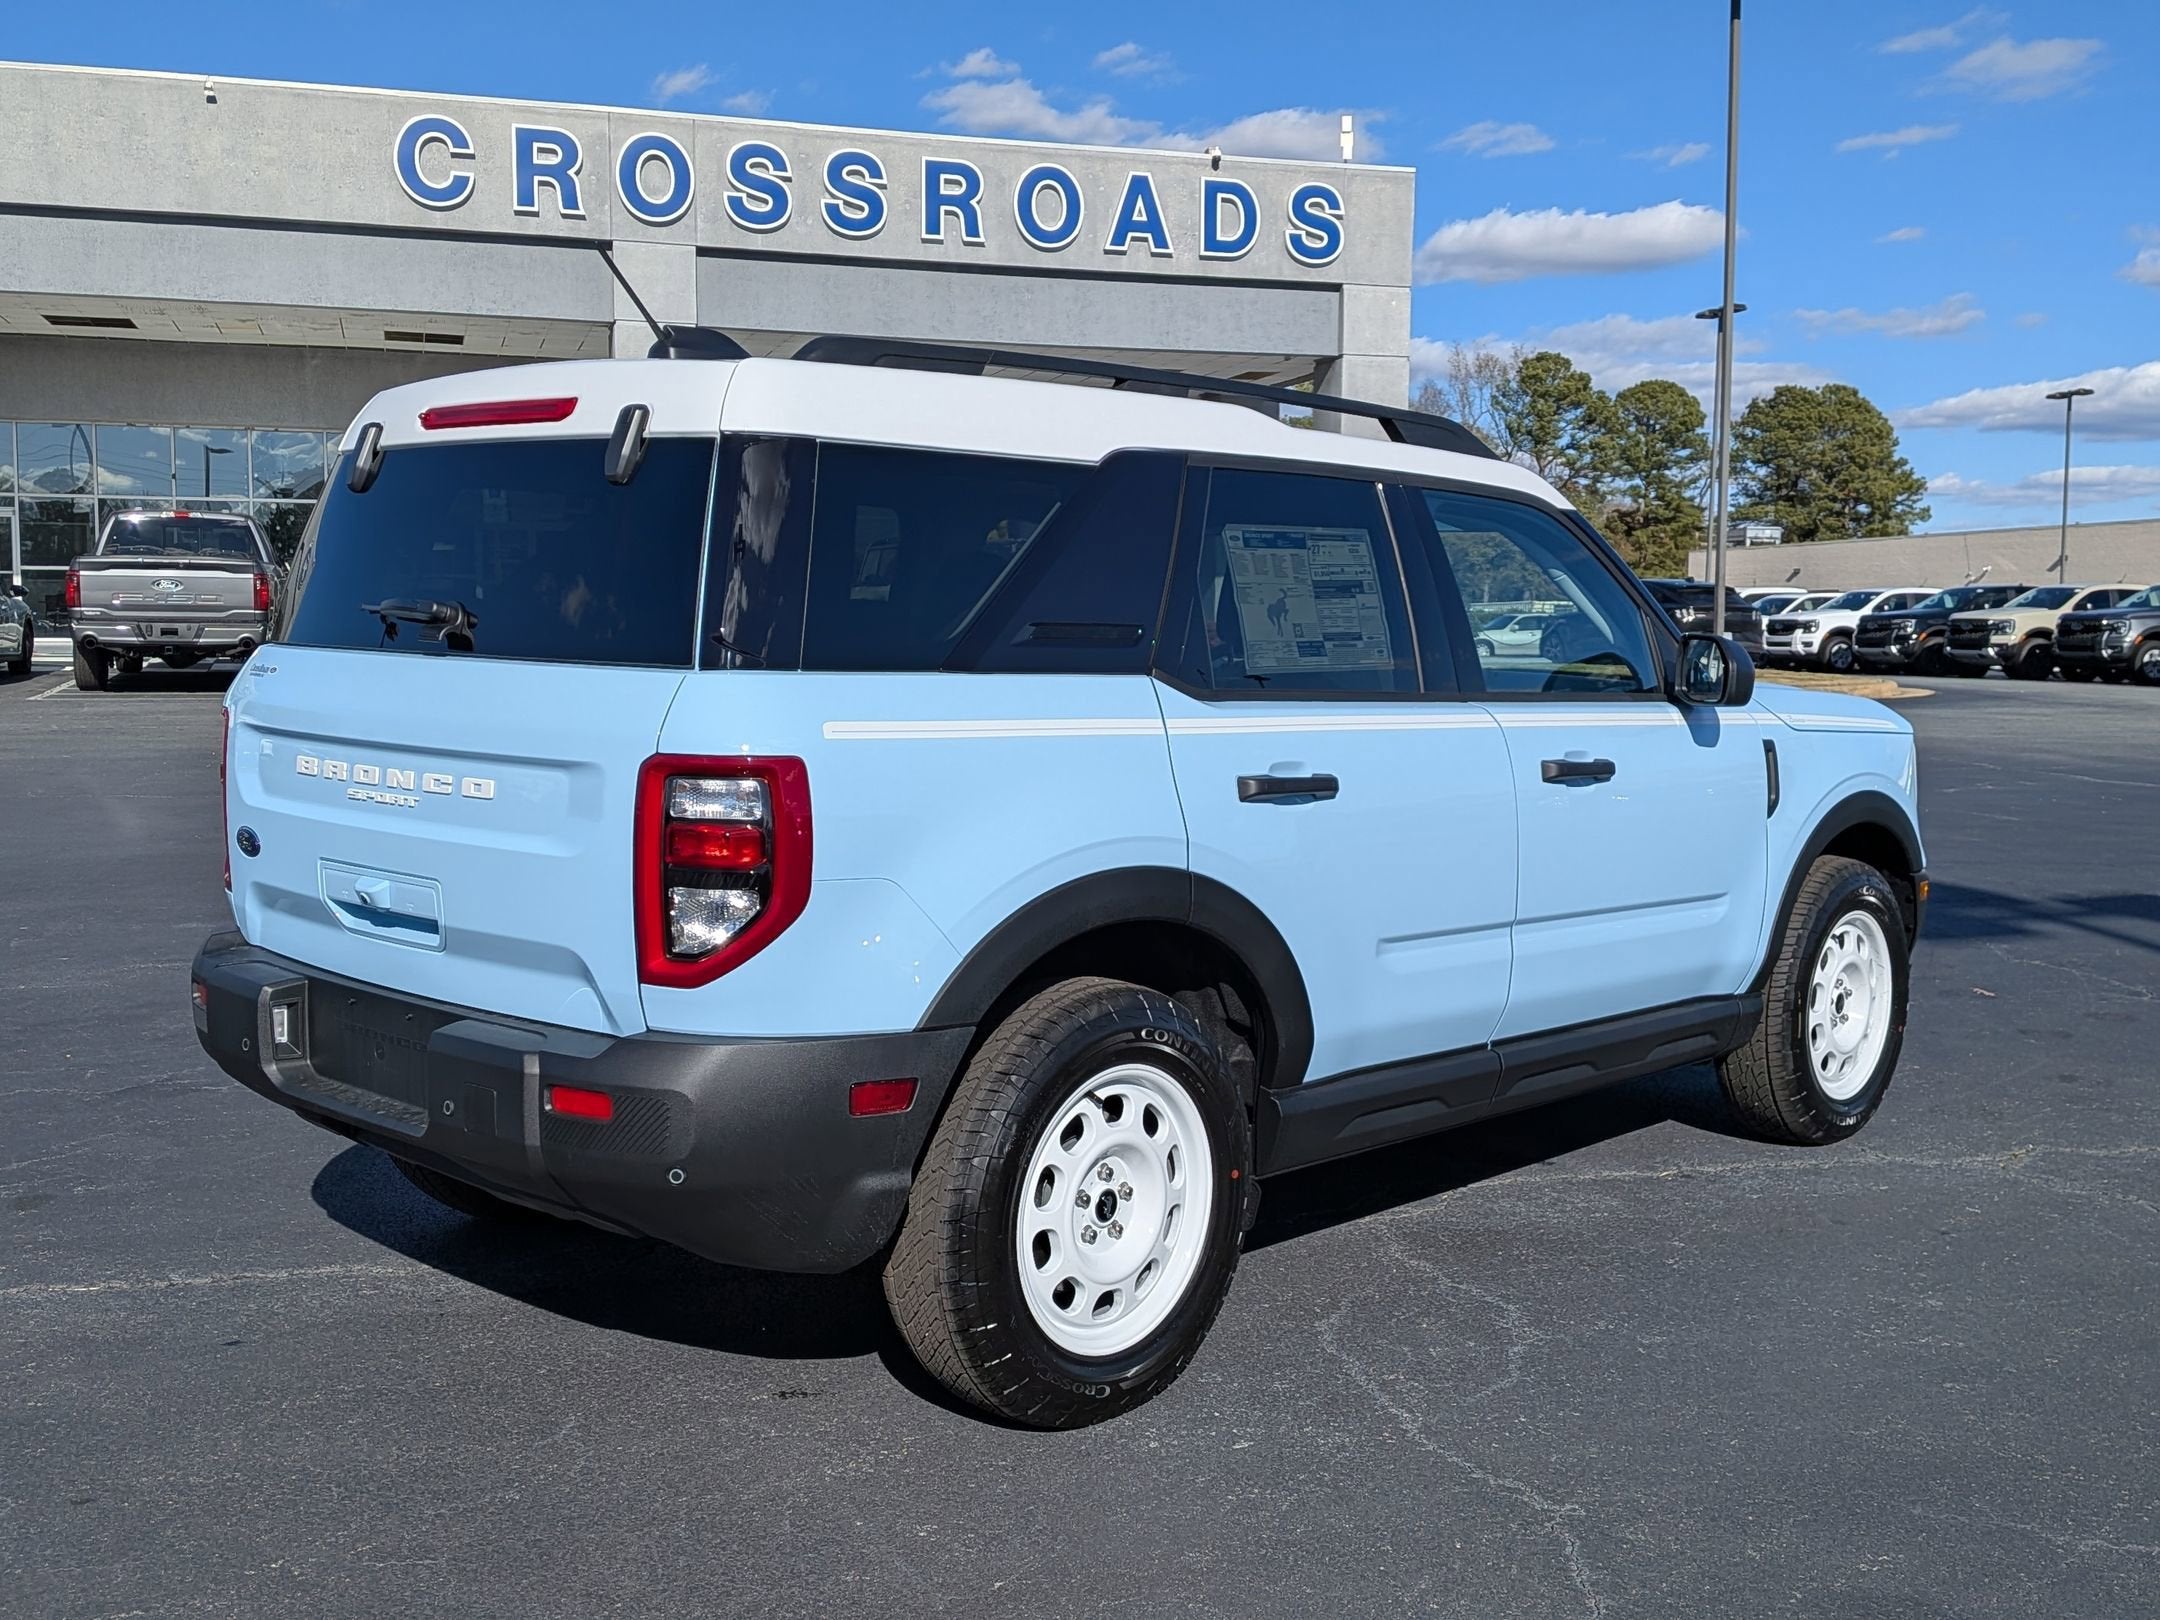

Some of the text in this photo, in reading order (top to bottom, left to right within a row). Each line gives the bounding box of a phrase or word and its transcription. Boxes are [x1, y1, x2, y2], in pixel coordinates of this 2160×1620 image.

[393, 113, 1346, 265] CROSSROADS
[111, 592, 225, 605] F-150
[296, 755, 496, 800] BRONCO
[346, 787, 420, 808] SPORT
